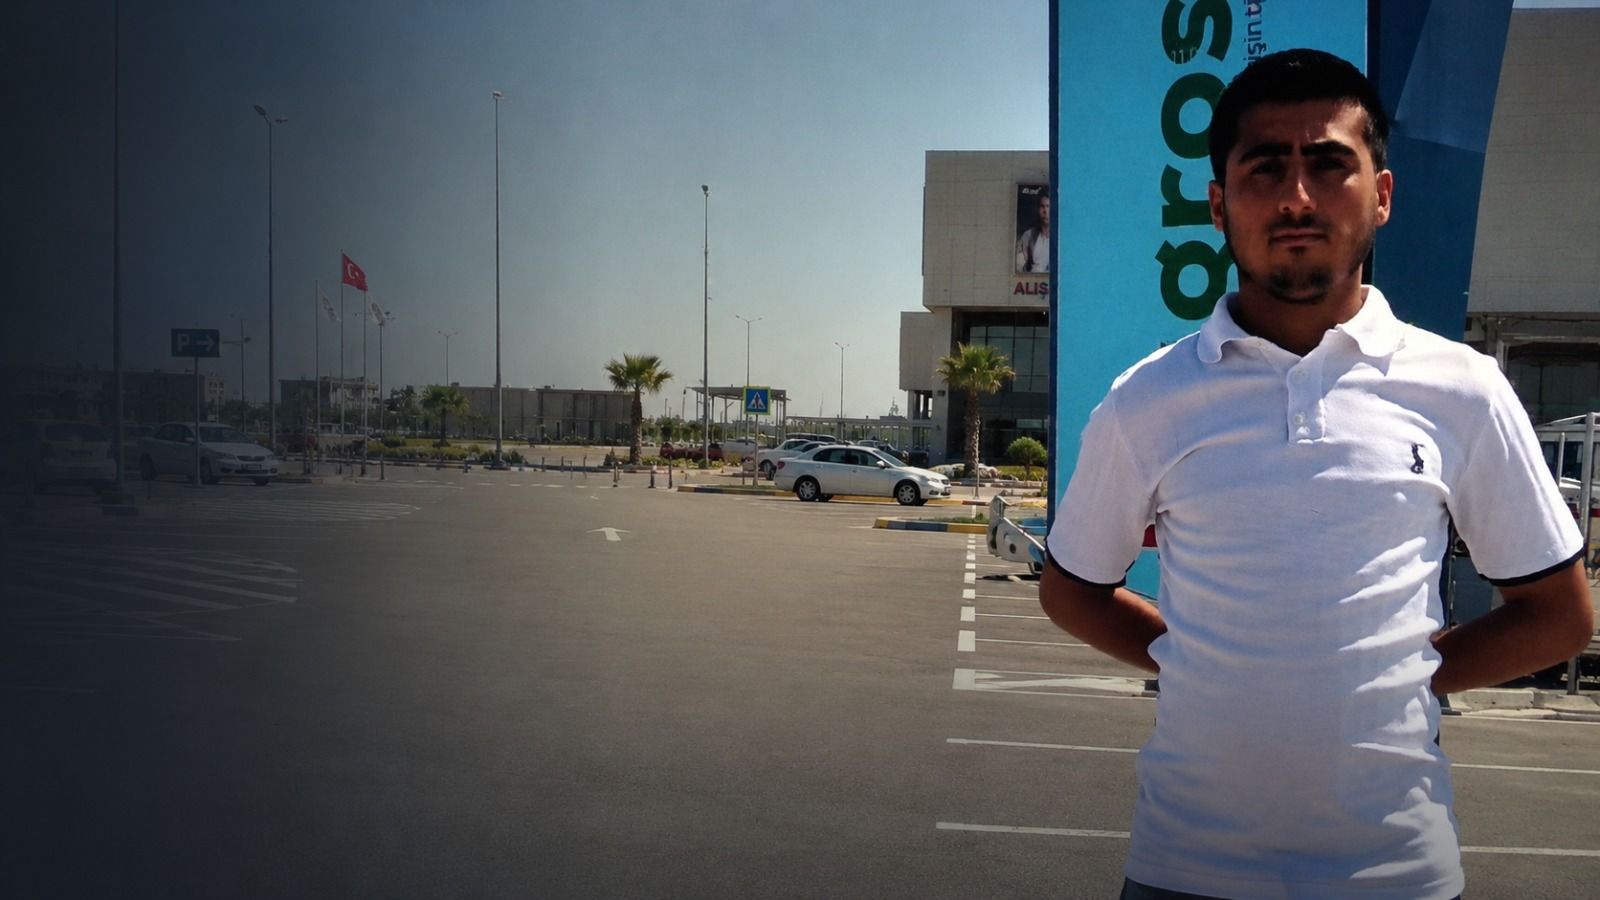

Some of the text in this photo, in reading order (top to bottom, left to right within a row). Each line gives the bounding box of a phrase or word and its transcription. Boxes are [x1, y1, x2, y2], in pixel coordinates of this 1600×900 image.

[1243, 20, 1266, 64] işin
[1155, 0, 1233, 320] gros
[176, 333, 190, 351] P
